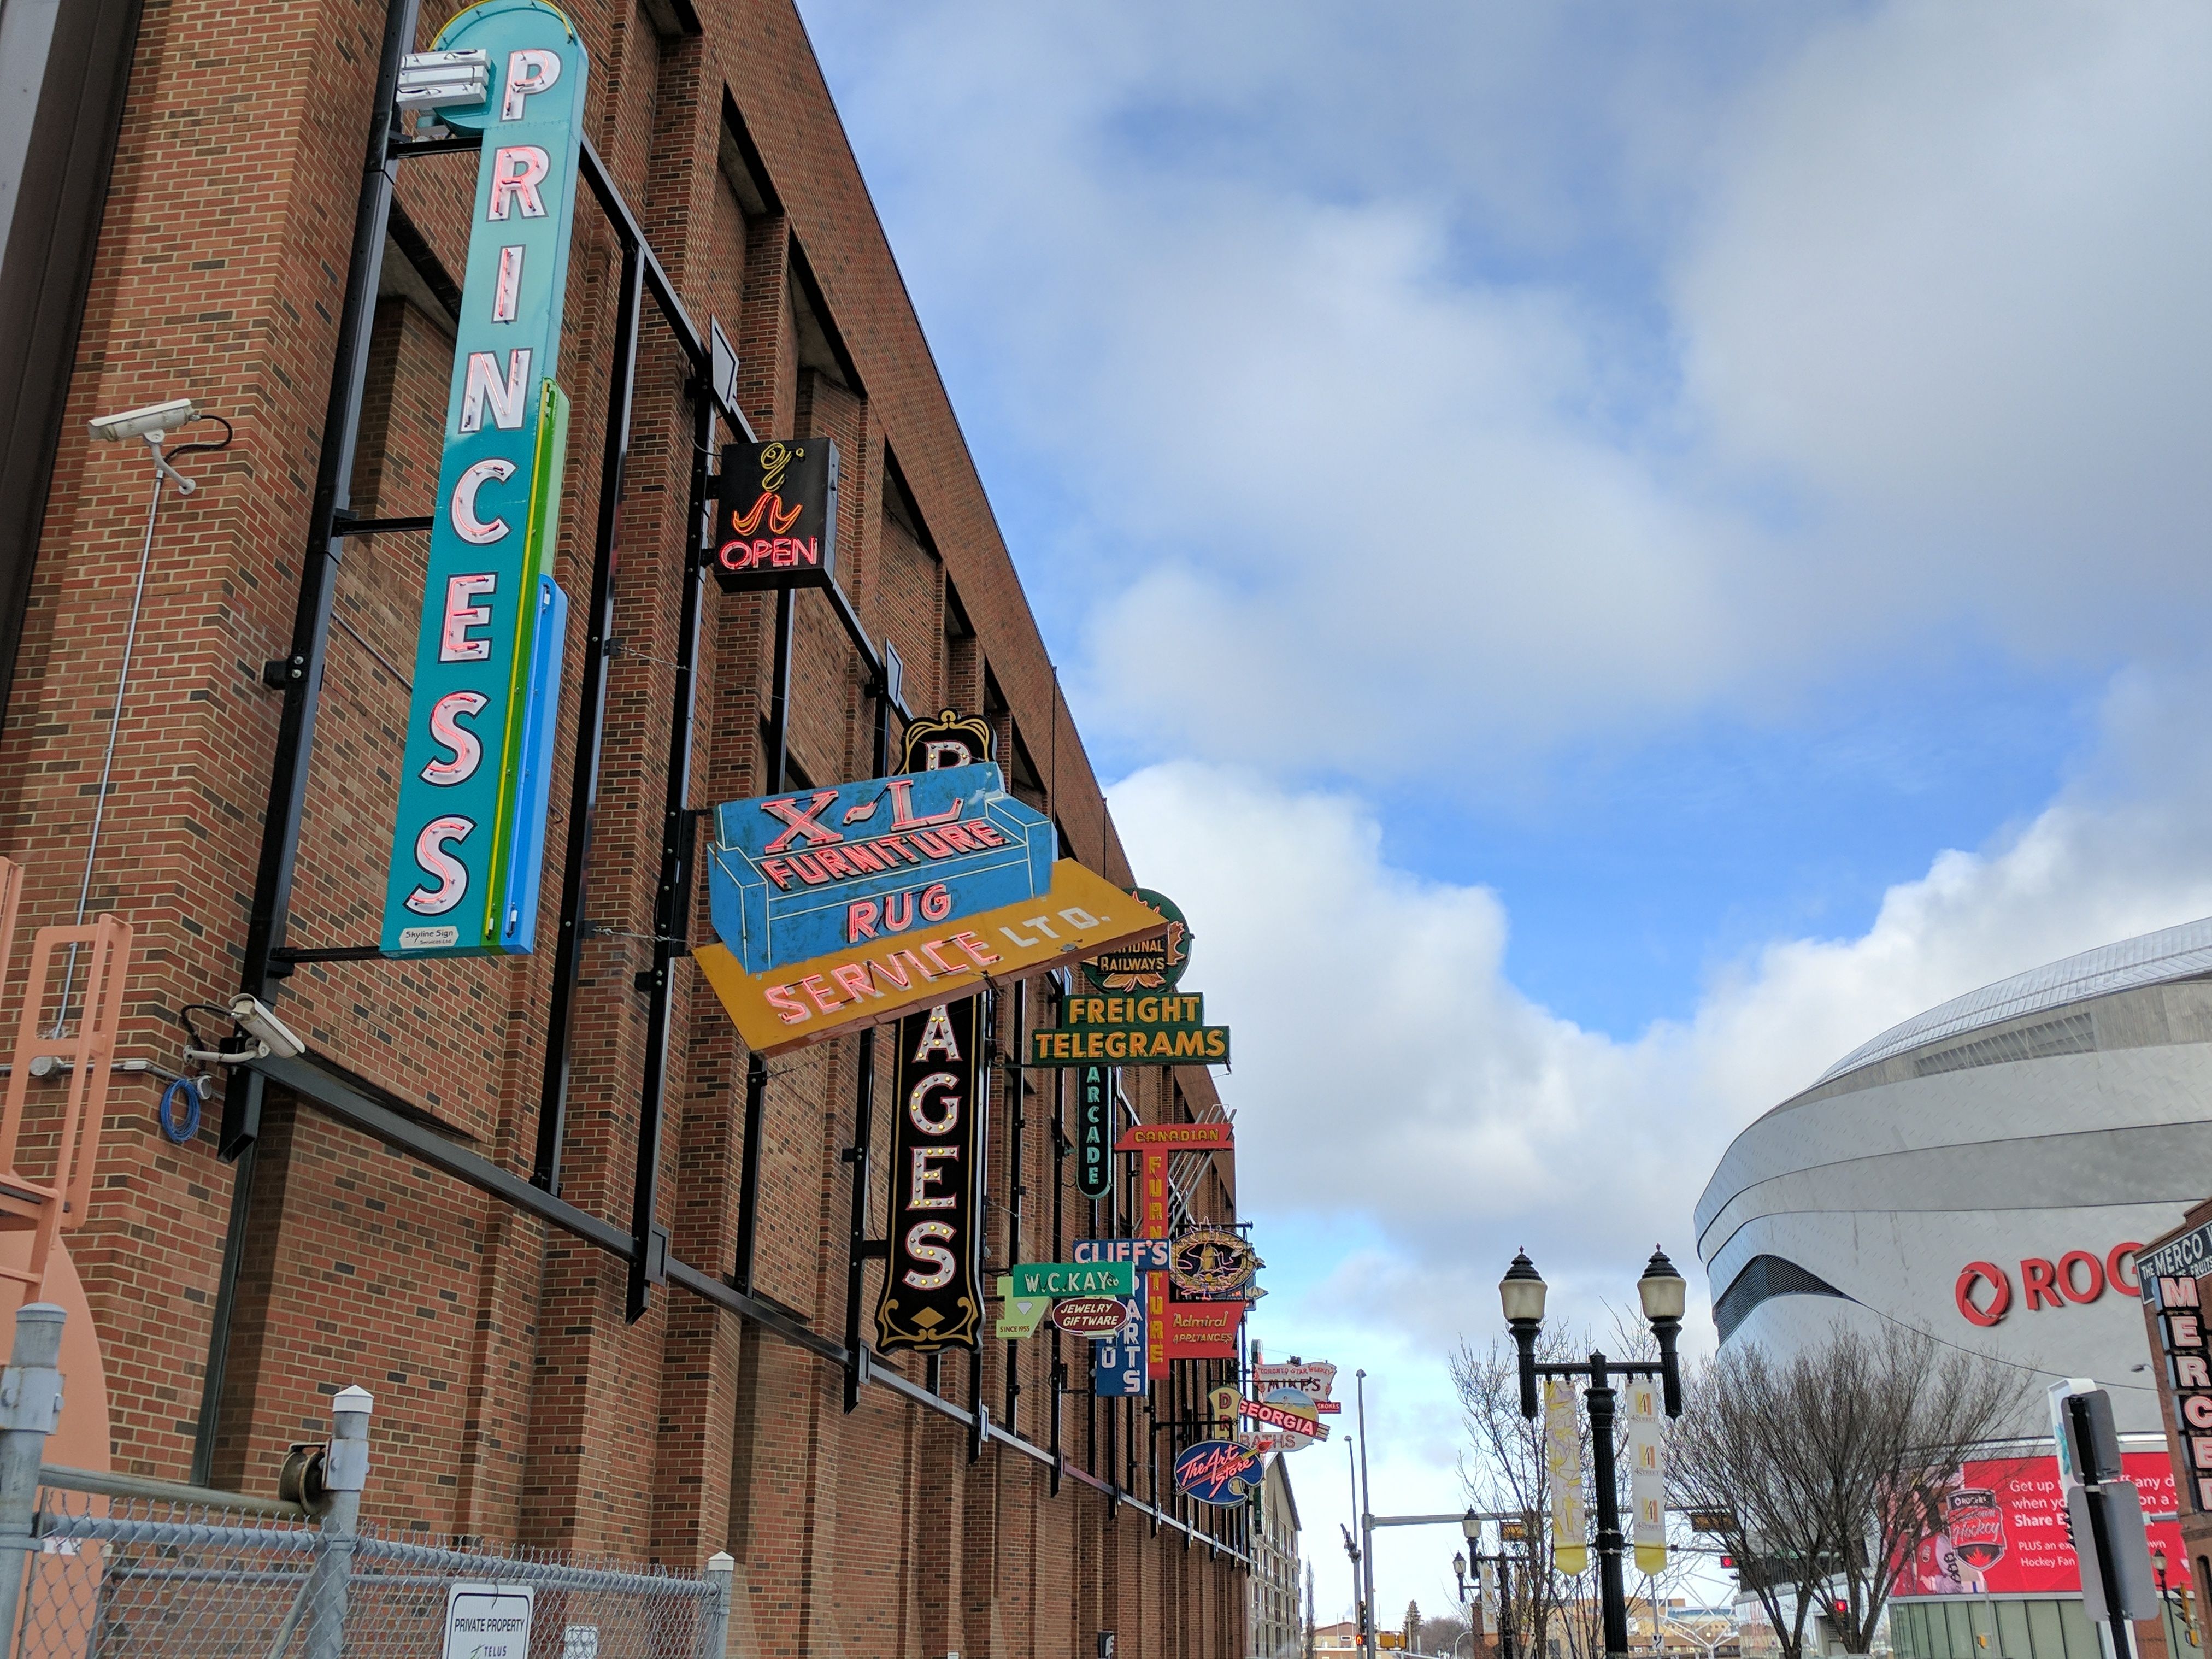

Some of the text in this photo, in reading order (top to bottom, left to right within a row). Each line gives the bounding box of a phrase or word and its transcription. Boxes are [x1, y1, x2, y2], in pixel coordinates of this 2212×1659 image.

[403, 48, 563, 916] PRINCESS
[720, 537, 817, 570] OPEN
[761, 821, 1010, 890] FURNITURE
[848, 883, 951, 943] RUG
[406, 929, 453, 943] Skyline Sign
[765, 907, 1111, 1025] SERVICE LTD.
[1101, 956, 1165, 972] RAILWAYS
[1069, 997, 1199, 1024] FREIGHT
[1036, 1030, 1226, 1059] TELEGRAMS
[1086, 1066, 1101, 1185] ARCADE
[1134, 1129, 1220, 1143] CANADIAN
[1074, 1240, 1168, 1266] CLIFF'S
[1149, 1156, 1163, 1363] FURNTURE
[2141, 1262, 2156, 1280] THE
[2154, 1233, 2203, 1276] MERCO
[1061, 1304, 1113, 1314] JEWELRY
[1173, 1311, 1229, 1328] Admiral
[1173, 1333, 1233, 1344] APPLIANCES
[1239, 1399, 1315, 1435] GEORGIA
[1240, 1434, 1295, 1449] BATHS
[1176, 1444, 1239, 1486] The Art
[1209, 1459, 1255, 1499] Store
[2010, 1479, 2034, 1492] Get
[2037, 1481, 2055, 1494] up
[2135, 1477, 2160, 1491] any
[2012, 1497, 2048, 1509] when
[2161, 1496, 2170, 1505] a
[2014, 1513, 2053, 1527] Share
[2018, 1541, 2043, 1551] PLUS
[2021, 1556, 2075, 1568] Hockey Fan
[454, 1617, 525, 1633] PRIVATE PROPERTY
[484, 1645, 507, 1657] TELUS
